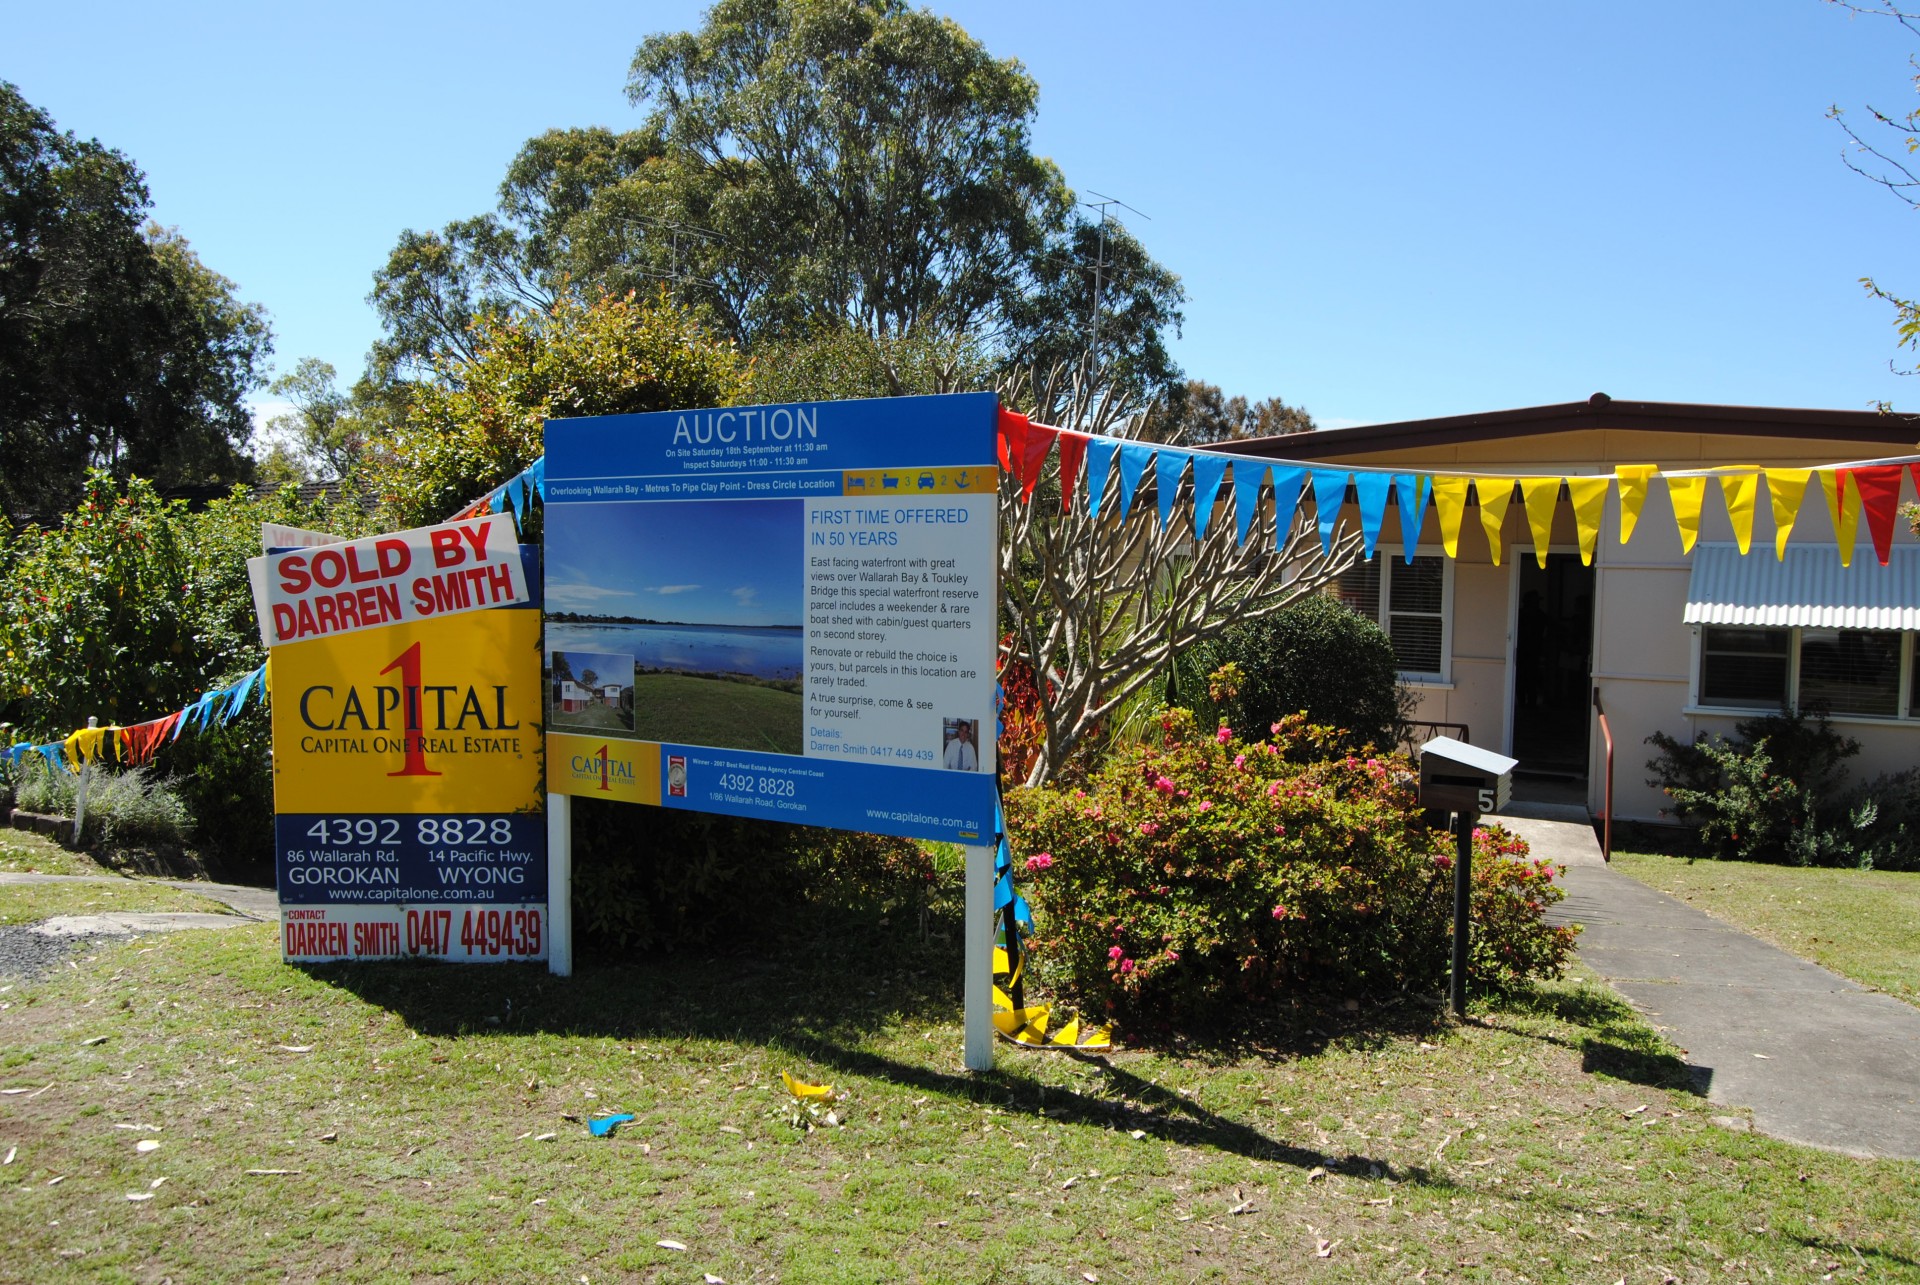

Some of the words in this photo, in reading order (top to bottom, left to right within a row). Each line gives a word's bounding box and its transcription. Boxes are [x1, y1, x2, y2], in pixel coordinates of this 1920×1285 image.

[673, 407, 817, 445] AUCTION
[666, 449, 675, 457] On
[677, 448, 691, 457] Site
[692, 448, 723, 457] Saturday
[726, 447, 741, 455] 18th
[743, 445, 782, 455] September
[794, 443, 814, 452] 11:30
[683, 461, 709, 470] Inspect
[711, 459, 747, 469] Saturdays
[749, 458, 768, 467] 11:00
[775, 457, 794, 466] 11:30
[551, 487, 592, 496] Overlooking
[593, 485, 623, 494] Wallarah
[625, 484, 639, 495] Bay
[645, 484, 670, 493] Metres
[672, 483, 680, 492] To
[683, 483, 699, 493] Pipe
[701, 482, 717, 493] Clay
[720, 481, 740, 491] Point
[747, 481, 770, 490] Dress
[772, 480, 797, 489] Circle
[799, 479, 835, 489] Location
[870, 477, 875, 487] 2
[905, 476, 910, 486] 3
[941, 475, 947, 485] 2
[811, 510, 852, 525] FIRST
[855, 510, 890, 524] TIME
[894, 509, 968, 524] OFFERED
[811, 532, 825, 546] IN
[829, 532, 845, 546] 50
[849, 531, 898, 546] YEARS
[278, 539, 411, 594] SOLD
[430, 522, 491, 568] BY
[811, 557, 830, 567] East
[832, 557, 859, 569] facing
[861, 557, 906, 568] waterfront
[909, 557, 928, 568] with
[930, 558, 955, 570] great
[810, 573, 835, 582] views
[837, 574, 856, 582] over
[859, 572, 898, 582] Wallarah
[901, 572, 919, 585] Bay
[921, 573, 928, 583] &
[931, 573, 968, 586] Toukley
[811, 586, 838, 598] Bridge
[841, 587, 856, 596] this
[859, 587, 890, 598] special
[893, 588, 939, 598] waterfront
[942, 590, 979, 599] reserve
[272, 584, 402, 641] DARREN
[412, 563, 514, 616] SMITH
[810, 601, 836, 611] parcel
[840, 601, 875, 611] includes
[887, 603, 937, 613] weekender
[940, 603, 947, 613] &
[810, 614, 829, 624] boat
[832, 615, 853, 625] shed
[856, 616, 874, 625] with
[876, 617, 929, 629] cabin/guest
[932, 619, 971, 630] quarters
[823, 630, 855, 639] second
[857, 632, 887, 643] storey.
[810, 646, 851, 657] Renovate
[866, 649, 896, 660] rebuild
[899, 650, 913, 661] the
[916, 651, 947, 662] choice
[949, 653, 957, 663] is
[810, 662, 836, 672] yours,
[839, 662, 853, 672] but
[855, 664, 887, 674] parcels
[890, 665, 898, 674] in
[901, 665, 918, 676] this
[920, 666, 957, 678] location
[960, 670, 976, 678] are
[810, 676, 834, 687] rarely
[837, 677, 867, 687] traded.
[300, 685, 519, 731] CAPITAL
[380, 641, 442, 776] 1
[810, 692, 817, 701] A
[818, 693, 835, 703] true
[838, 696, 876, 707] surprise,
[878, 699, 903, 708] come
[907, 698, 913, 708] &
[916, 701, 933, 709] see
[810, 707, 821, 716] for
[824, 709, 861, 719] yourself.
[811, 727, 842, 739] Details:
[811, 741, 839, 752] Darren
[843, 744, 867, 755] Smith
[871, 747, 892, 757] 0417
[895, 748, 913, 759] 449
[916, 750, 933, 760] 439
[571, 756, 636, 778] CAPITAL
[693, 758, 710, 766] Winner
[768, 766, 787, 774] Agency
[788, 768, 807, 776] Central
[720, 773, 754, 792] 4392
[759, 777, 795, 797] 8828
[709, 792, 723, 801] 1/86
[724, 794, 753, 805] Wallarah
[755, 797, 775, 808] Road,
[777, 800, 806, 811] Gorokan
[1478, 789, 1494, 813] 5
[867, 809, 978, 829] www.capitalone.com.au
[306, 819, 401, 845] 4392
[417, 819, 512, 845] 8828
[287, 851, 305, 862] 86
[310, 850, 371, 862] Wallarah
[376, 850, 399, 862] Rd.
[428, 851, 445, 862] 14
[450, 850, 495, 862] Pacific
[500, 851, 533, 864] Hwy.
[289, 867, 399, 884] GOROKAN
[438, 867, 524, 884] WYONG
[328, 887, 495, 900] www.capitalone.com.au
[288, 910, 326, 920] CONTACT
[286, 922, 348, 956] DARREN
[354, 922, 399, 956] SMITH
[407, 910, 451, 955] 0417
[461, 910, 541, 955] 449439
